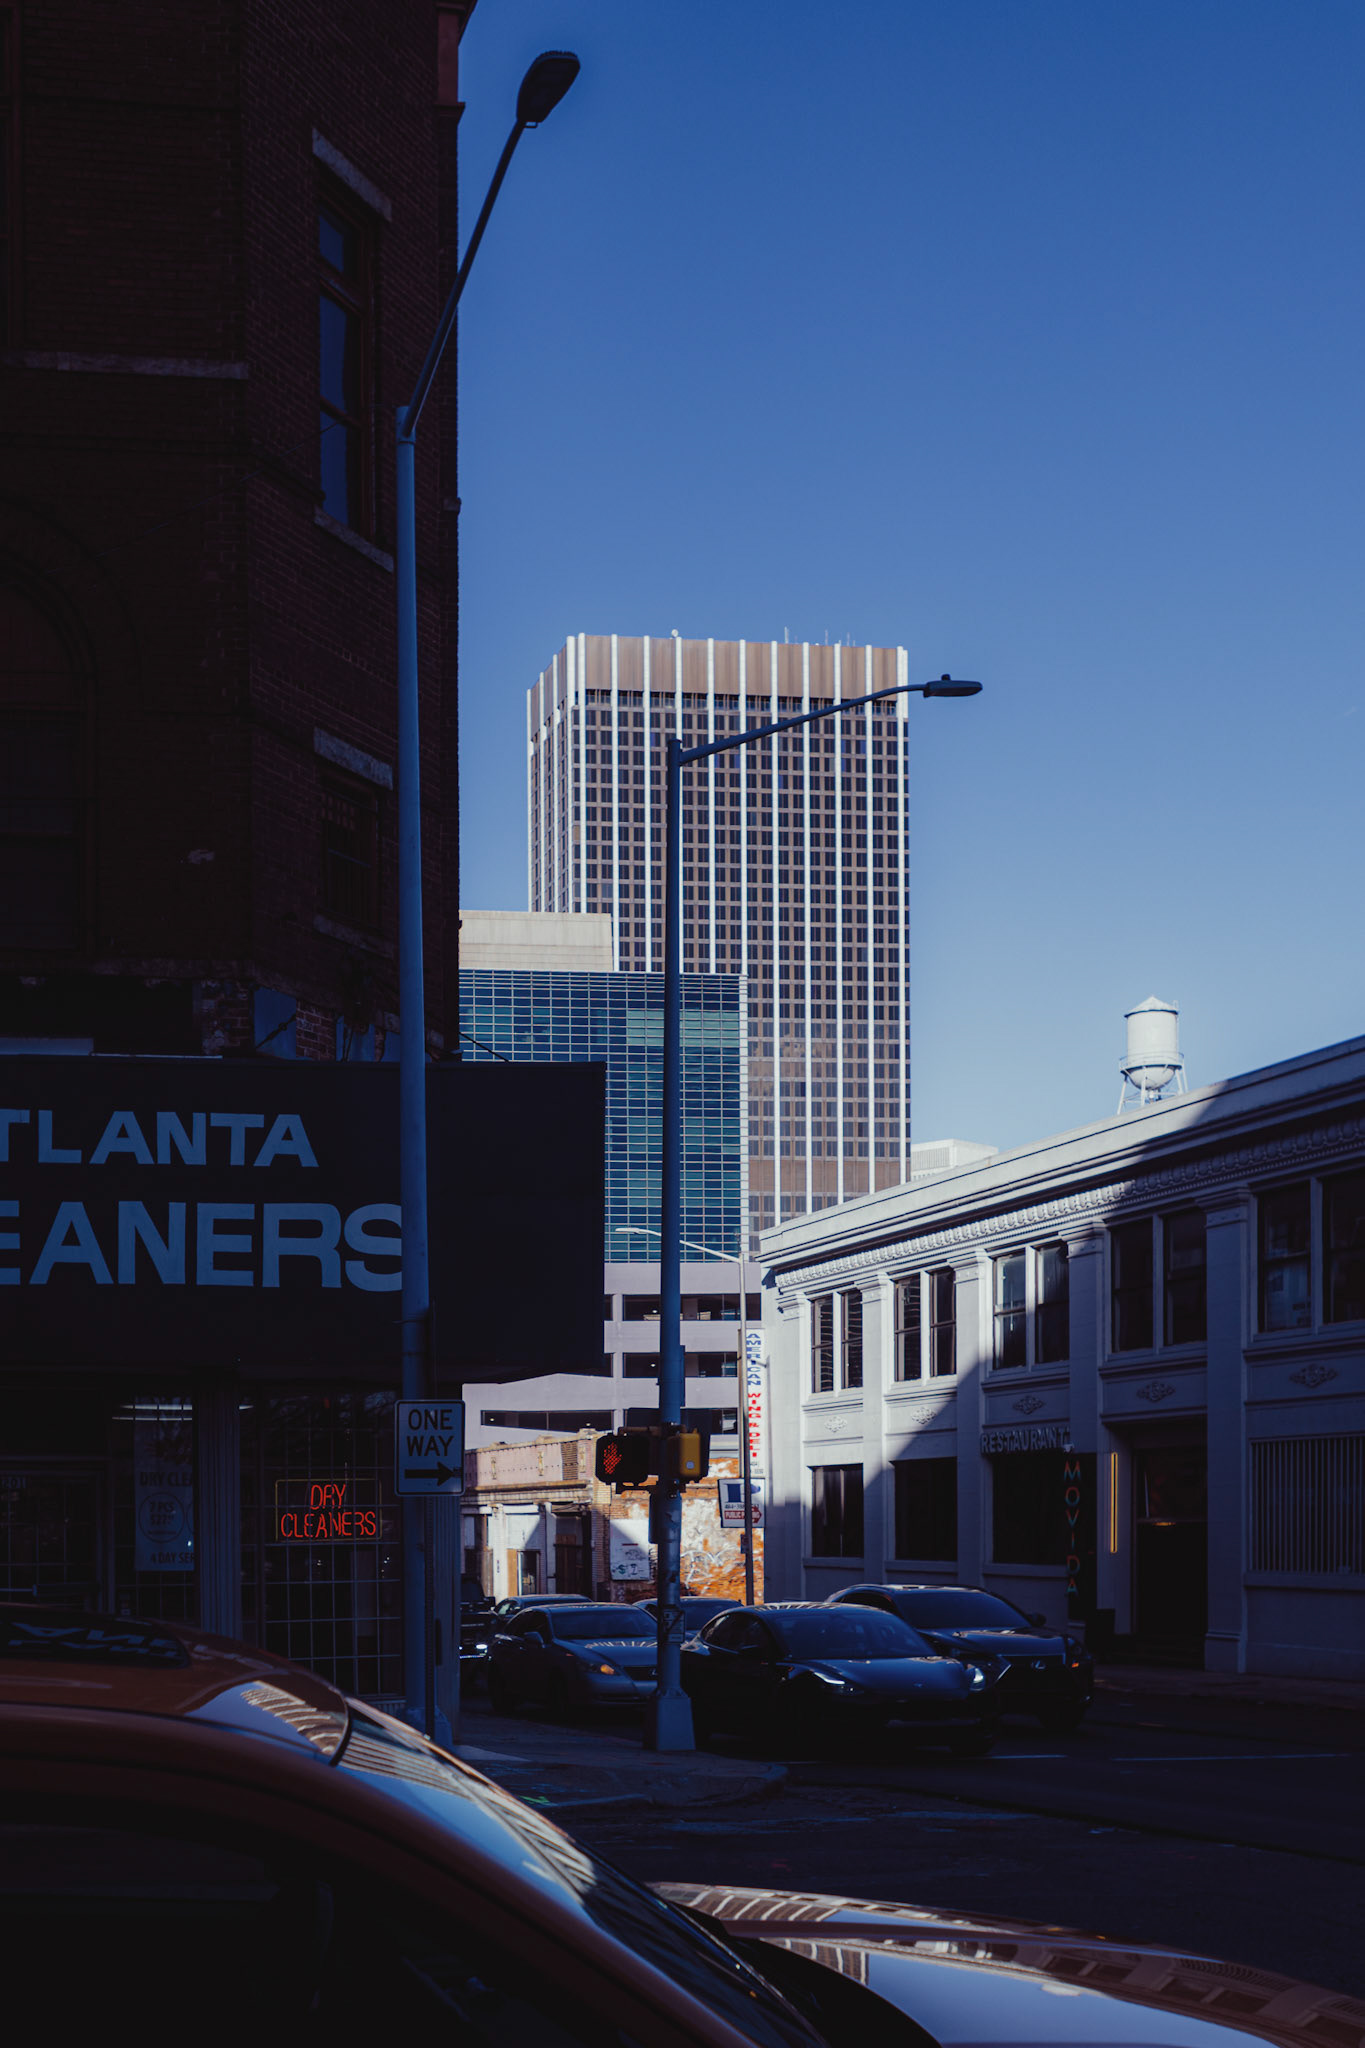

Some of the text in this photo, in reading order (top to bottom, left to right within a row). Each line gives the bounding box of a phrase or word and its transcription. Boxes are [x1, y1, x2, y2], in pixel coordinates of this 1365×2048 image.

[748, 1392, 761, 1418] WING
[408, 1409, 453, 1431] ONE
[407, 1435, 454, 1457] WAY
[981, 1426, 1070, 1454] RESTAURANT
[140, 1471, 166, 1488] DRY
[310, 1483, 346, 1510] DRY
[281, 1511, 377, 1538] CLEANERS
[1063, 1459, 1081, 1596] MOVIDA
